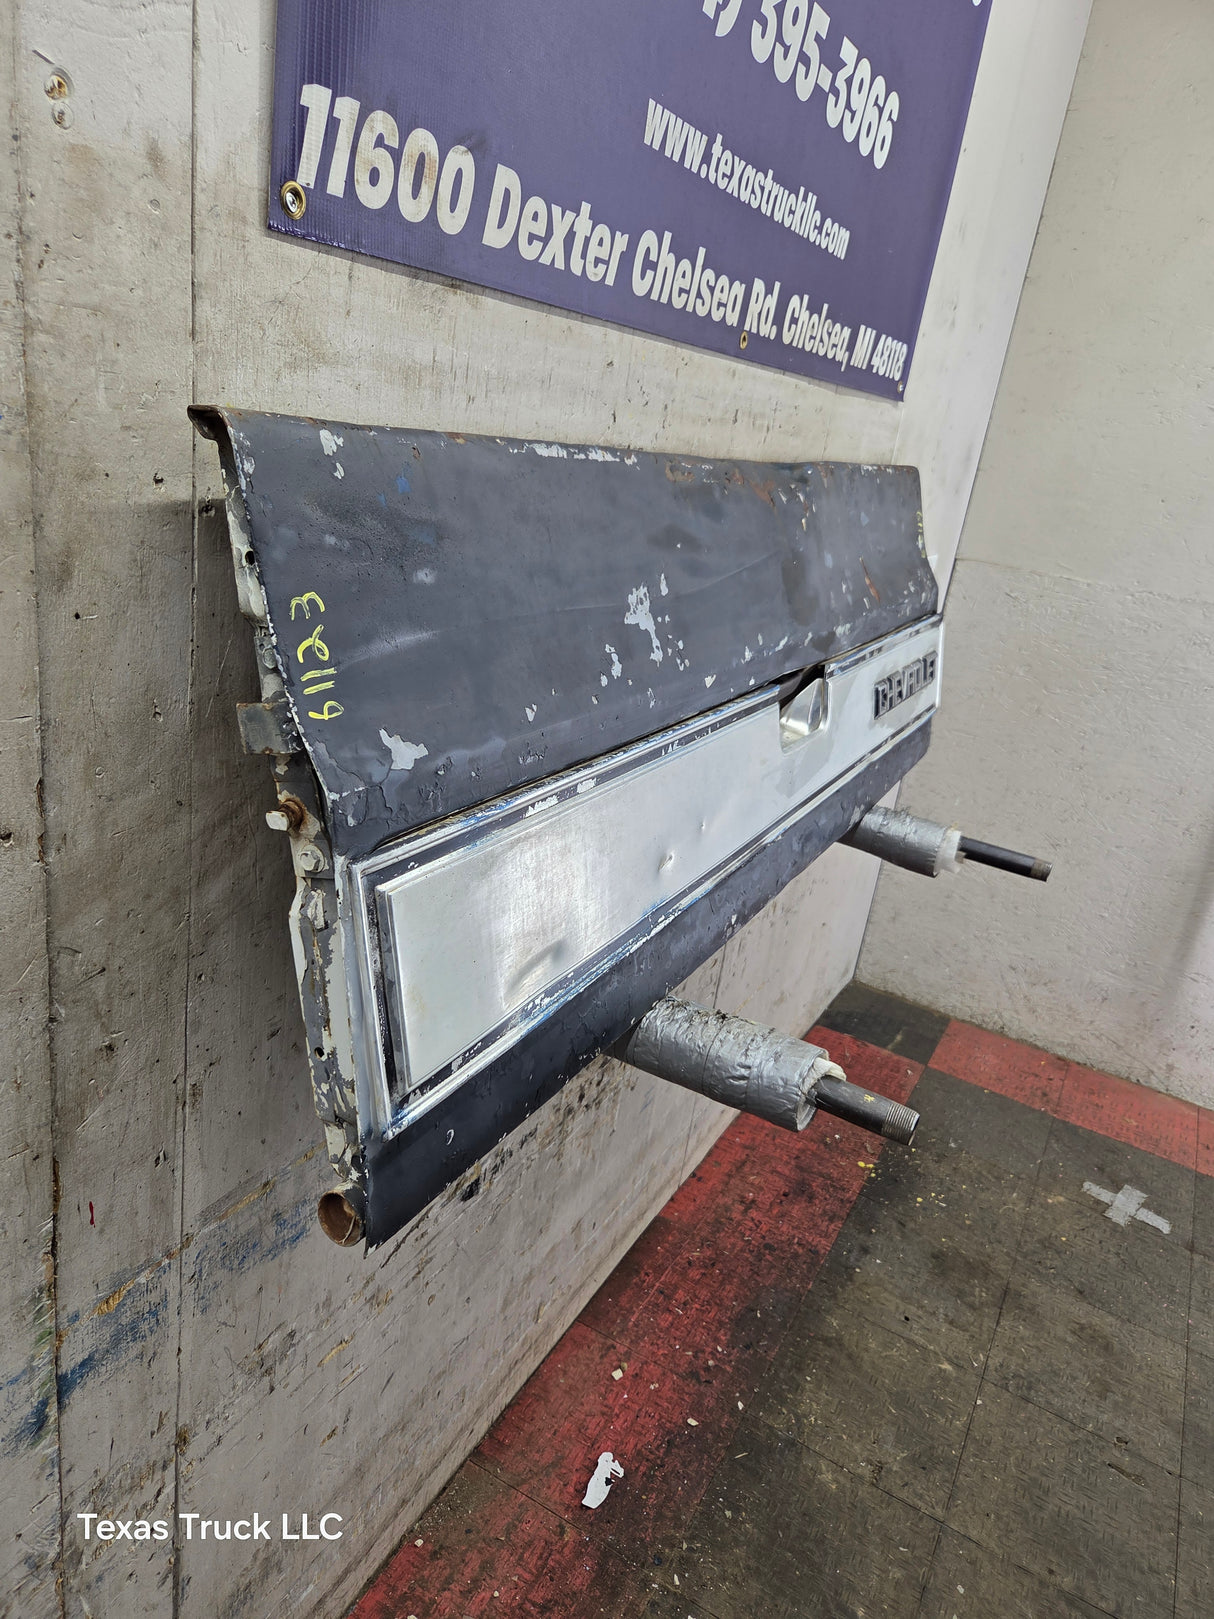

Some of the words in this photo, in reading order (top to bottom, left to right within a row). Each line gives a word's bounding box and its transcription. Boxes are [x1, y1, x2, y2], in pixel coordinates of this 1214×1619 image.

[751, 0, 900, 169] 395-3966
[296, 83, 475, 235] 11600
[482, 163, 629, 286] Dexter
[632, 229, 746, 327] Chelsea
[744, 278, 781, 340] Rd.
[782, 294, 852, 372] Chelsea,
[850, 325, 877, 370] MI
[871, 334, 909, 381] 48118
[644, 98, 850, 260] www.texastruckllc.com
